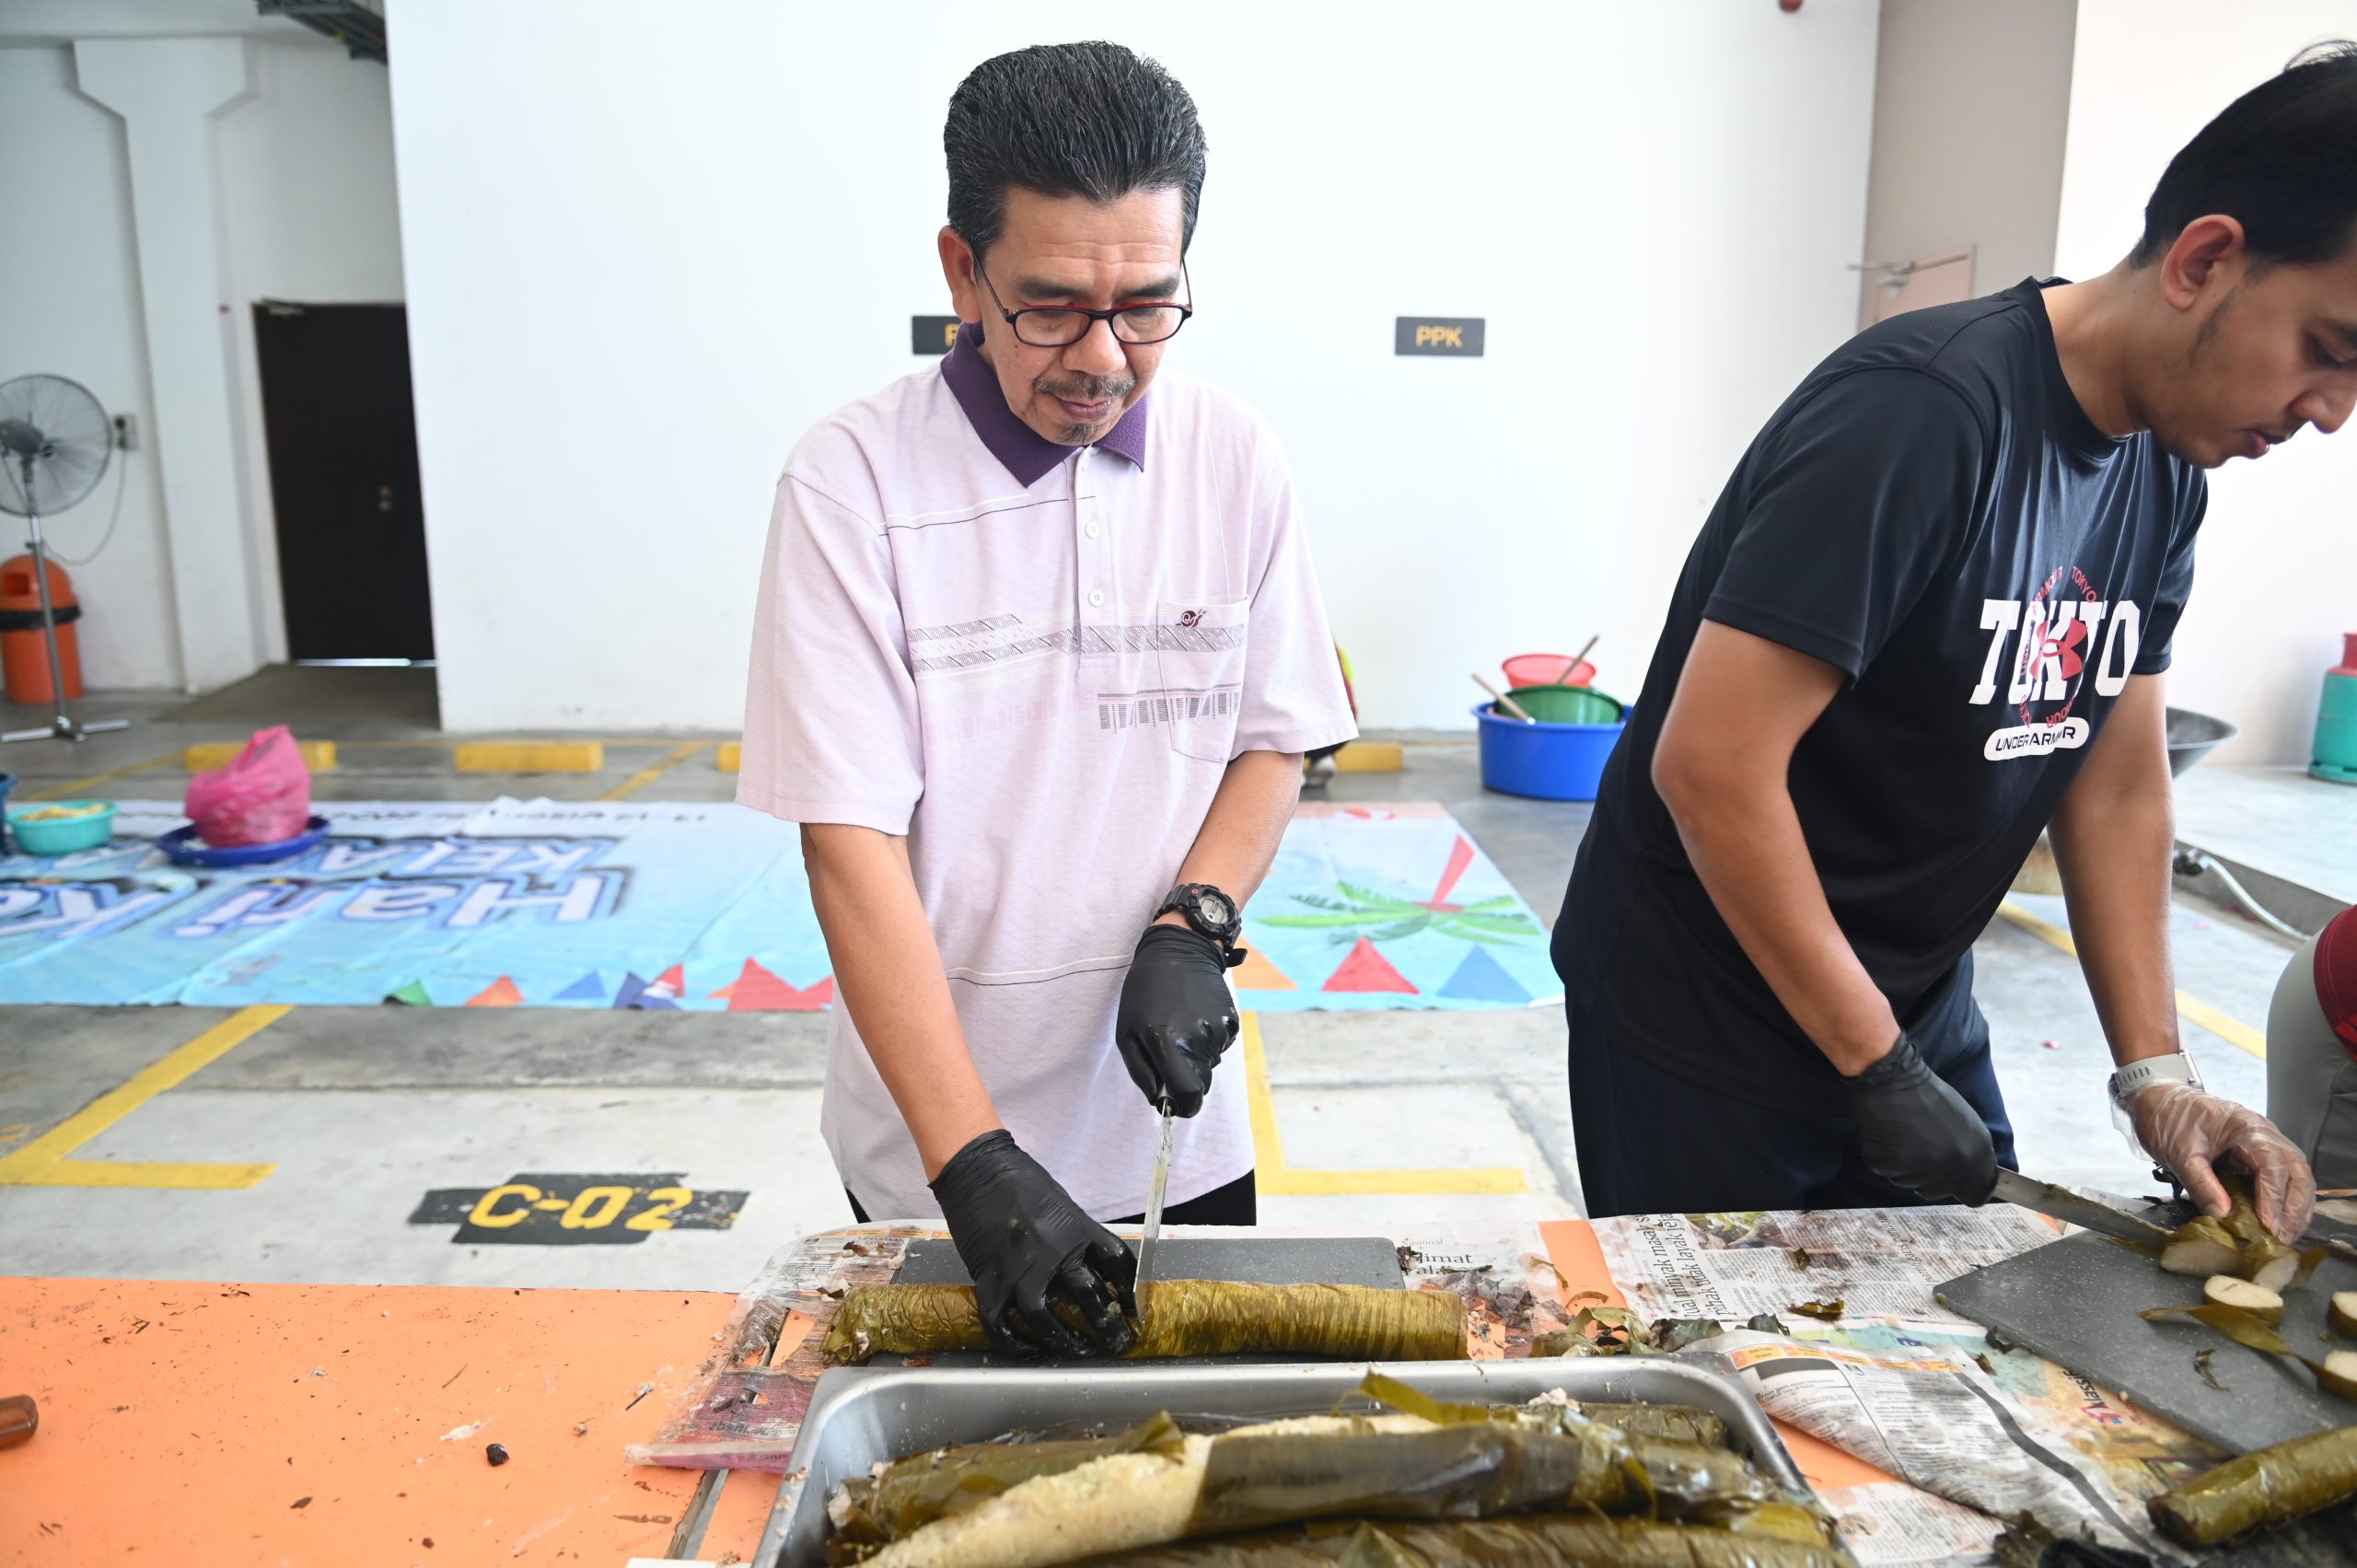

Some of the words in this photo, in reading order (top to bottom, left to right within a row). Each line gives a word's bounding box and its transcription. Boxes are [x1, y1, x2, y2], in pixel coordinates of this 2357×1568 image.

[1416, 325, 1463, 348] PPK
[2072, 566, 2097, 603] TOKYO
[1968, 599, 2140, 705] TOKYO
[172, 873, 608, 938] Hari
[469, 1184, 692, 1231] C-02
[1666, 1233, 1696, 1261] layak
[1899, 1243, 1922, 1267] garis
[1654, 1259, 1690, 1297] minyak
[1681, 1264, 1712, 1287] tidak
[1698, 1286, 1737, 1317] pihak
